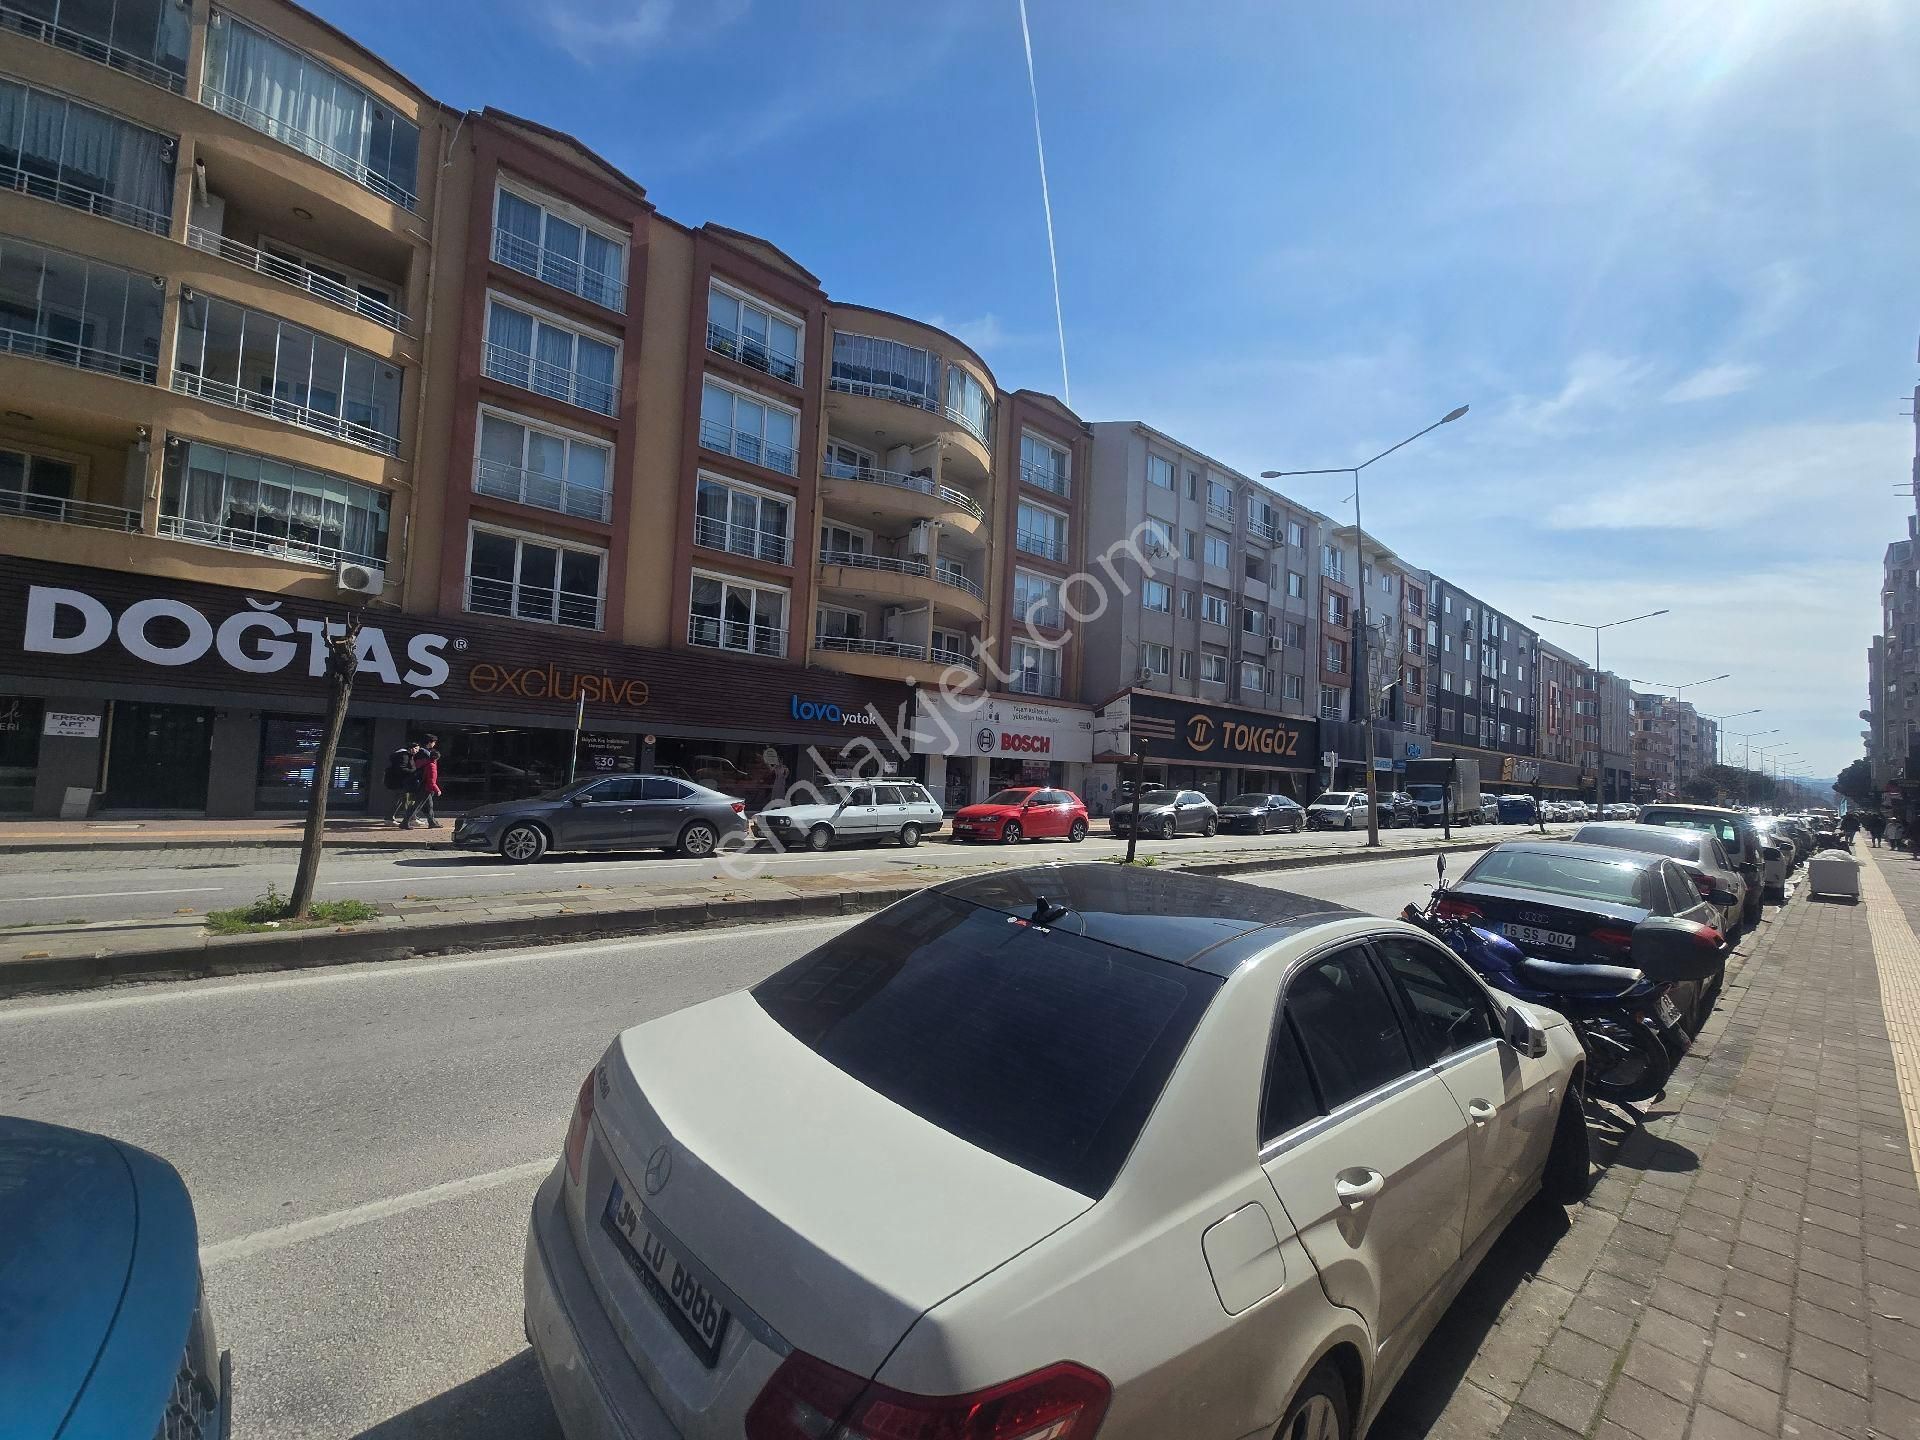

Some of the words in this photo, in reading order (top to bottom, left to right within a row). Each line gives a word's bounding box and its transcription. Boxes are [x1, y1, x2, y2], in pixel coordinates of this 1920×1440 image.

[24, 585, 450, 700] DOĞTAŞ
[469, 662, 649, 706] exclusive
[791, 694, 841, 722] lova
[842, 709, 876, 726] yatak
[1001, 733, 1050, 753] BOSCH
[1222, 721, 1298, 756] TOKGÖZ
[1503, 924, 1517, 936] 16
[1523, 928, 1539, 939] SS
[643, 1231, 666, 1273] LU
